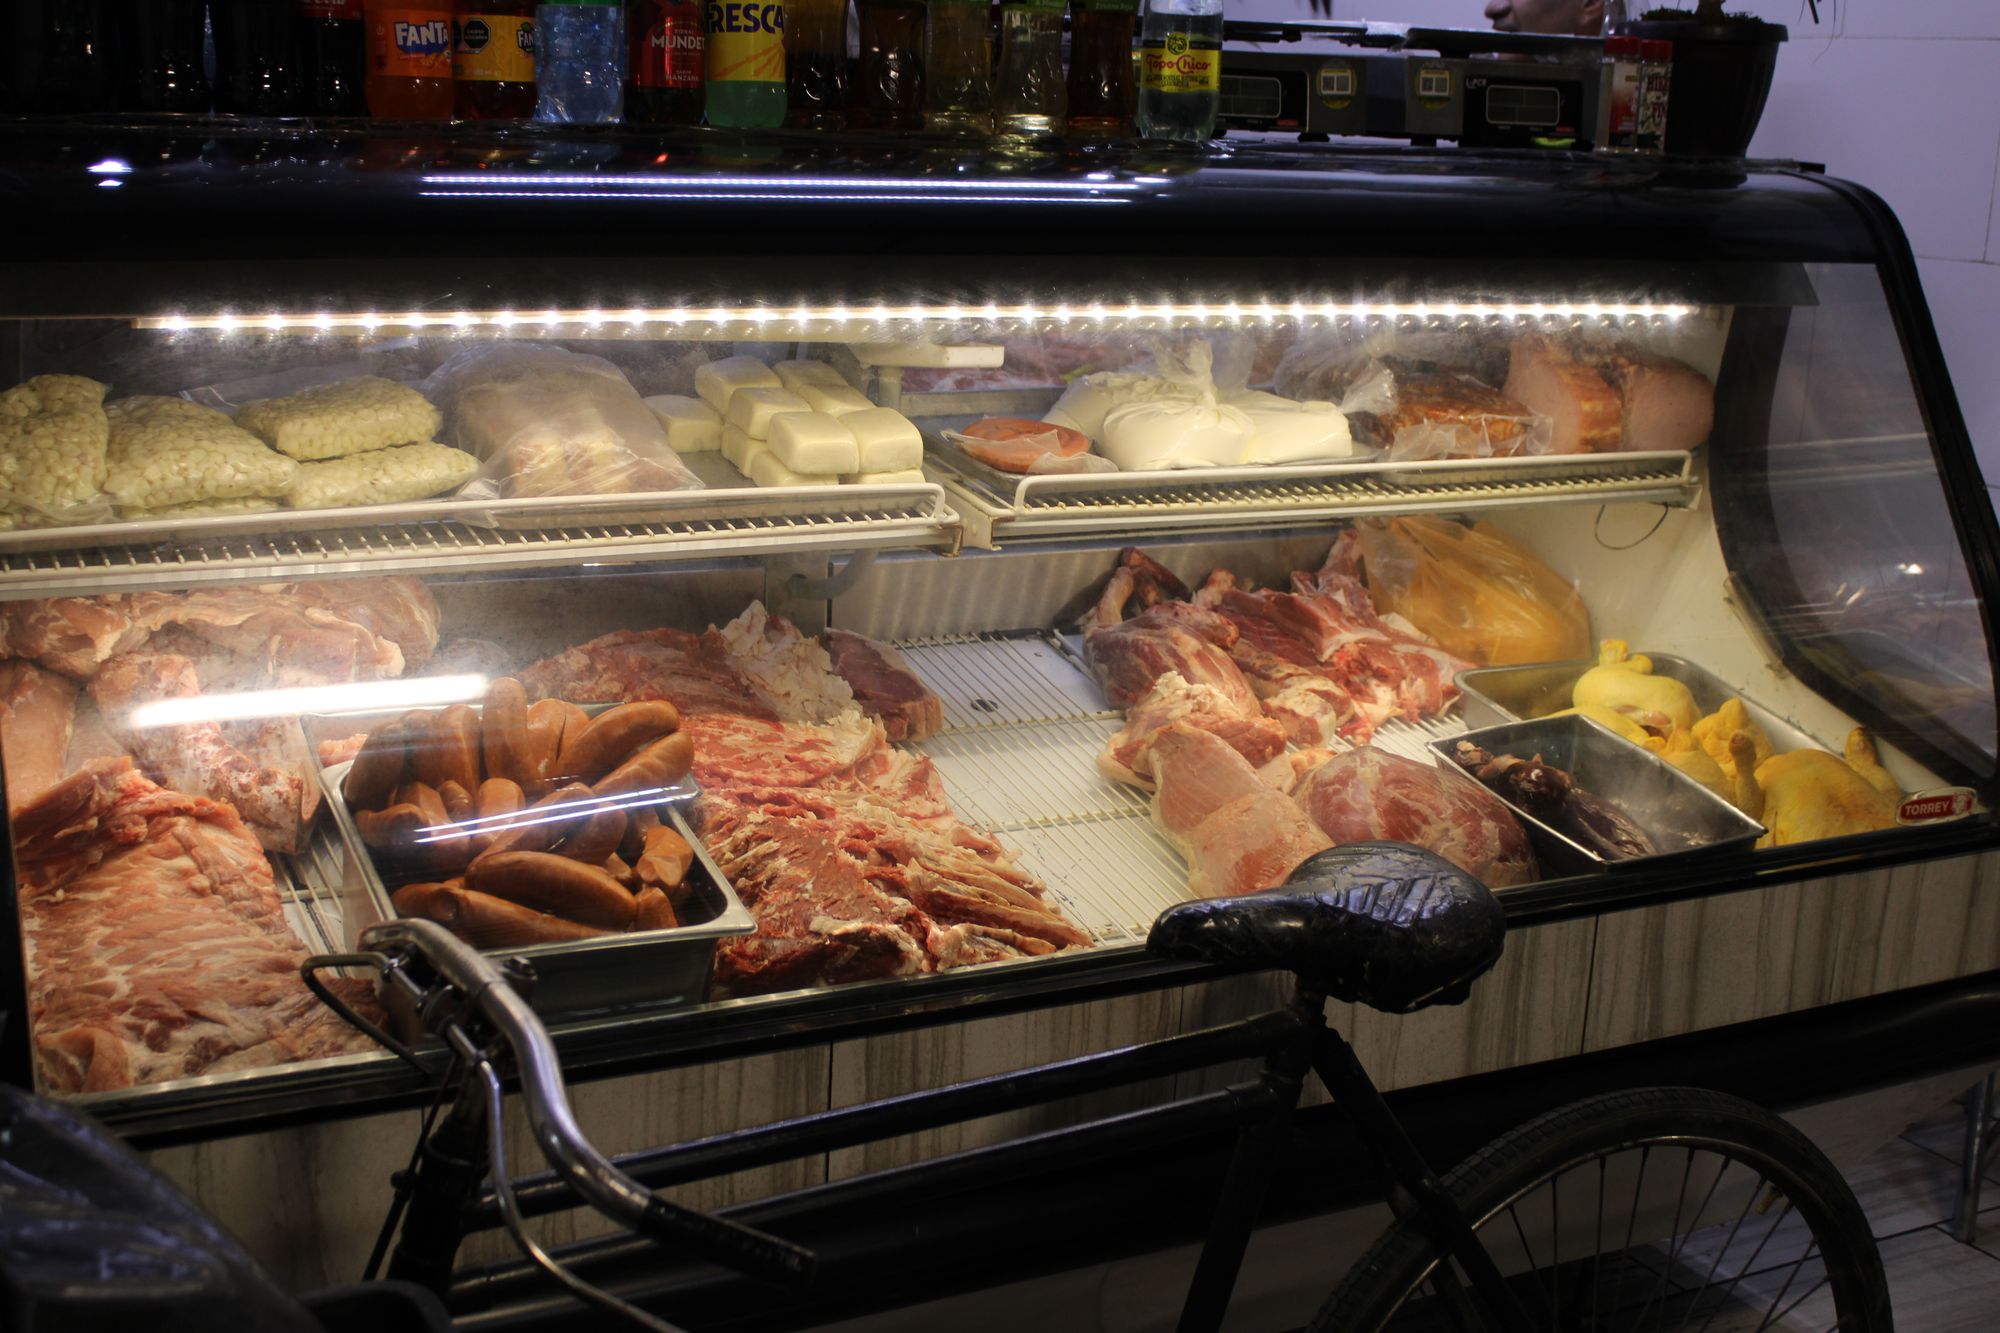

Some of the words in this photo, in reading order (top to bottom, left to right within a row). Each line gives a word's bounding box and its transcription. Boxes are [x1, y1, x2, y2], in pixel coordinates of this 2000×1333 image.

[1146, 54, 1177, 72] Topo
[1176, 54, 1211, 74] Chico
[1904, 800, 1950, 817] TORREY
